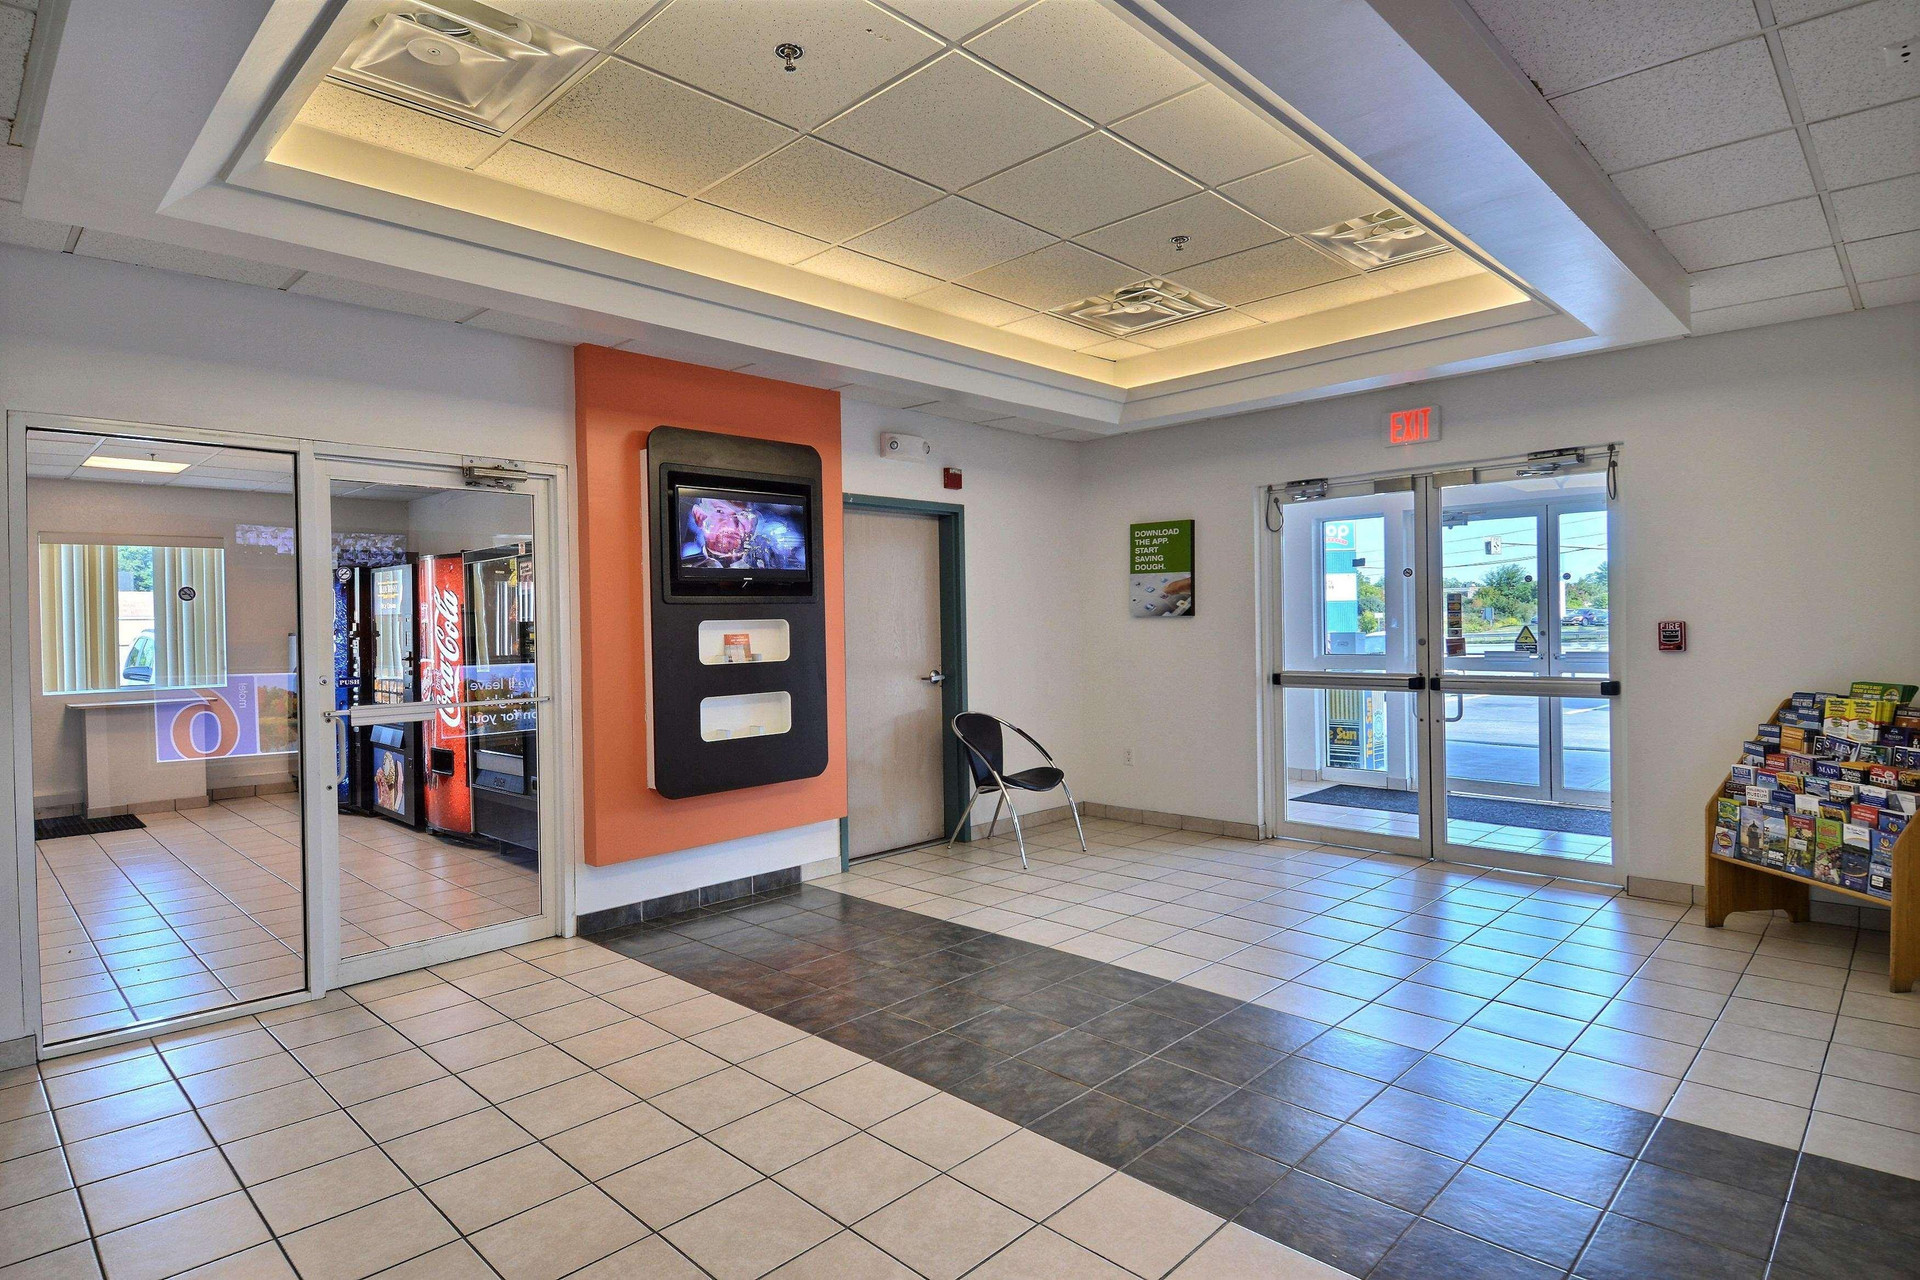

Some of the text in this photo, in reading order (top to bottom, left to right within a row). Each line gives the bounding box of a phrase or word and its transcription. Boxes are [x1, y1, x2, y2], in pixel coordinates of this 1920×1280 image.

[1390, 406, 1432, 444] EXIT
[1134, 528, 1180, 538] DOWNLOAD
[1134, 537, 1169, 546] THE APP.
[1134, 546, 1159, 555] START
[1134, 554, 1164, 563] SAVING
[1134, 563, 1166, 571] DOUGH.
[1660, 622, 1681, 630] FIRE
[1336, 727, 1357, 740] Sun
[1746, 791, 1768, 799] MUSEUM
